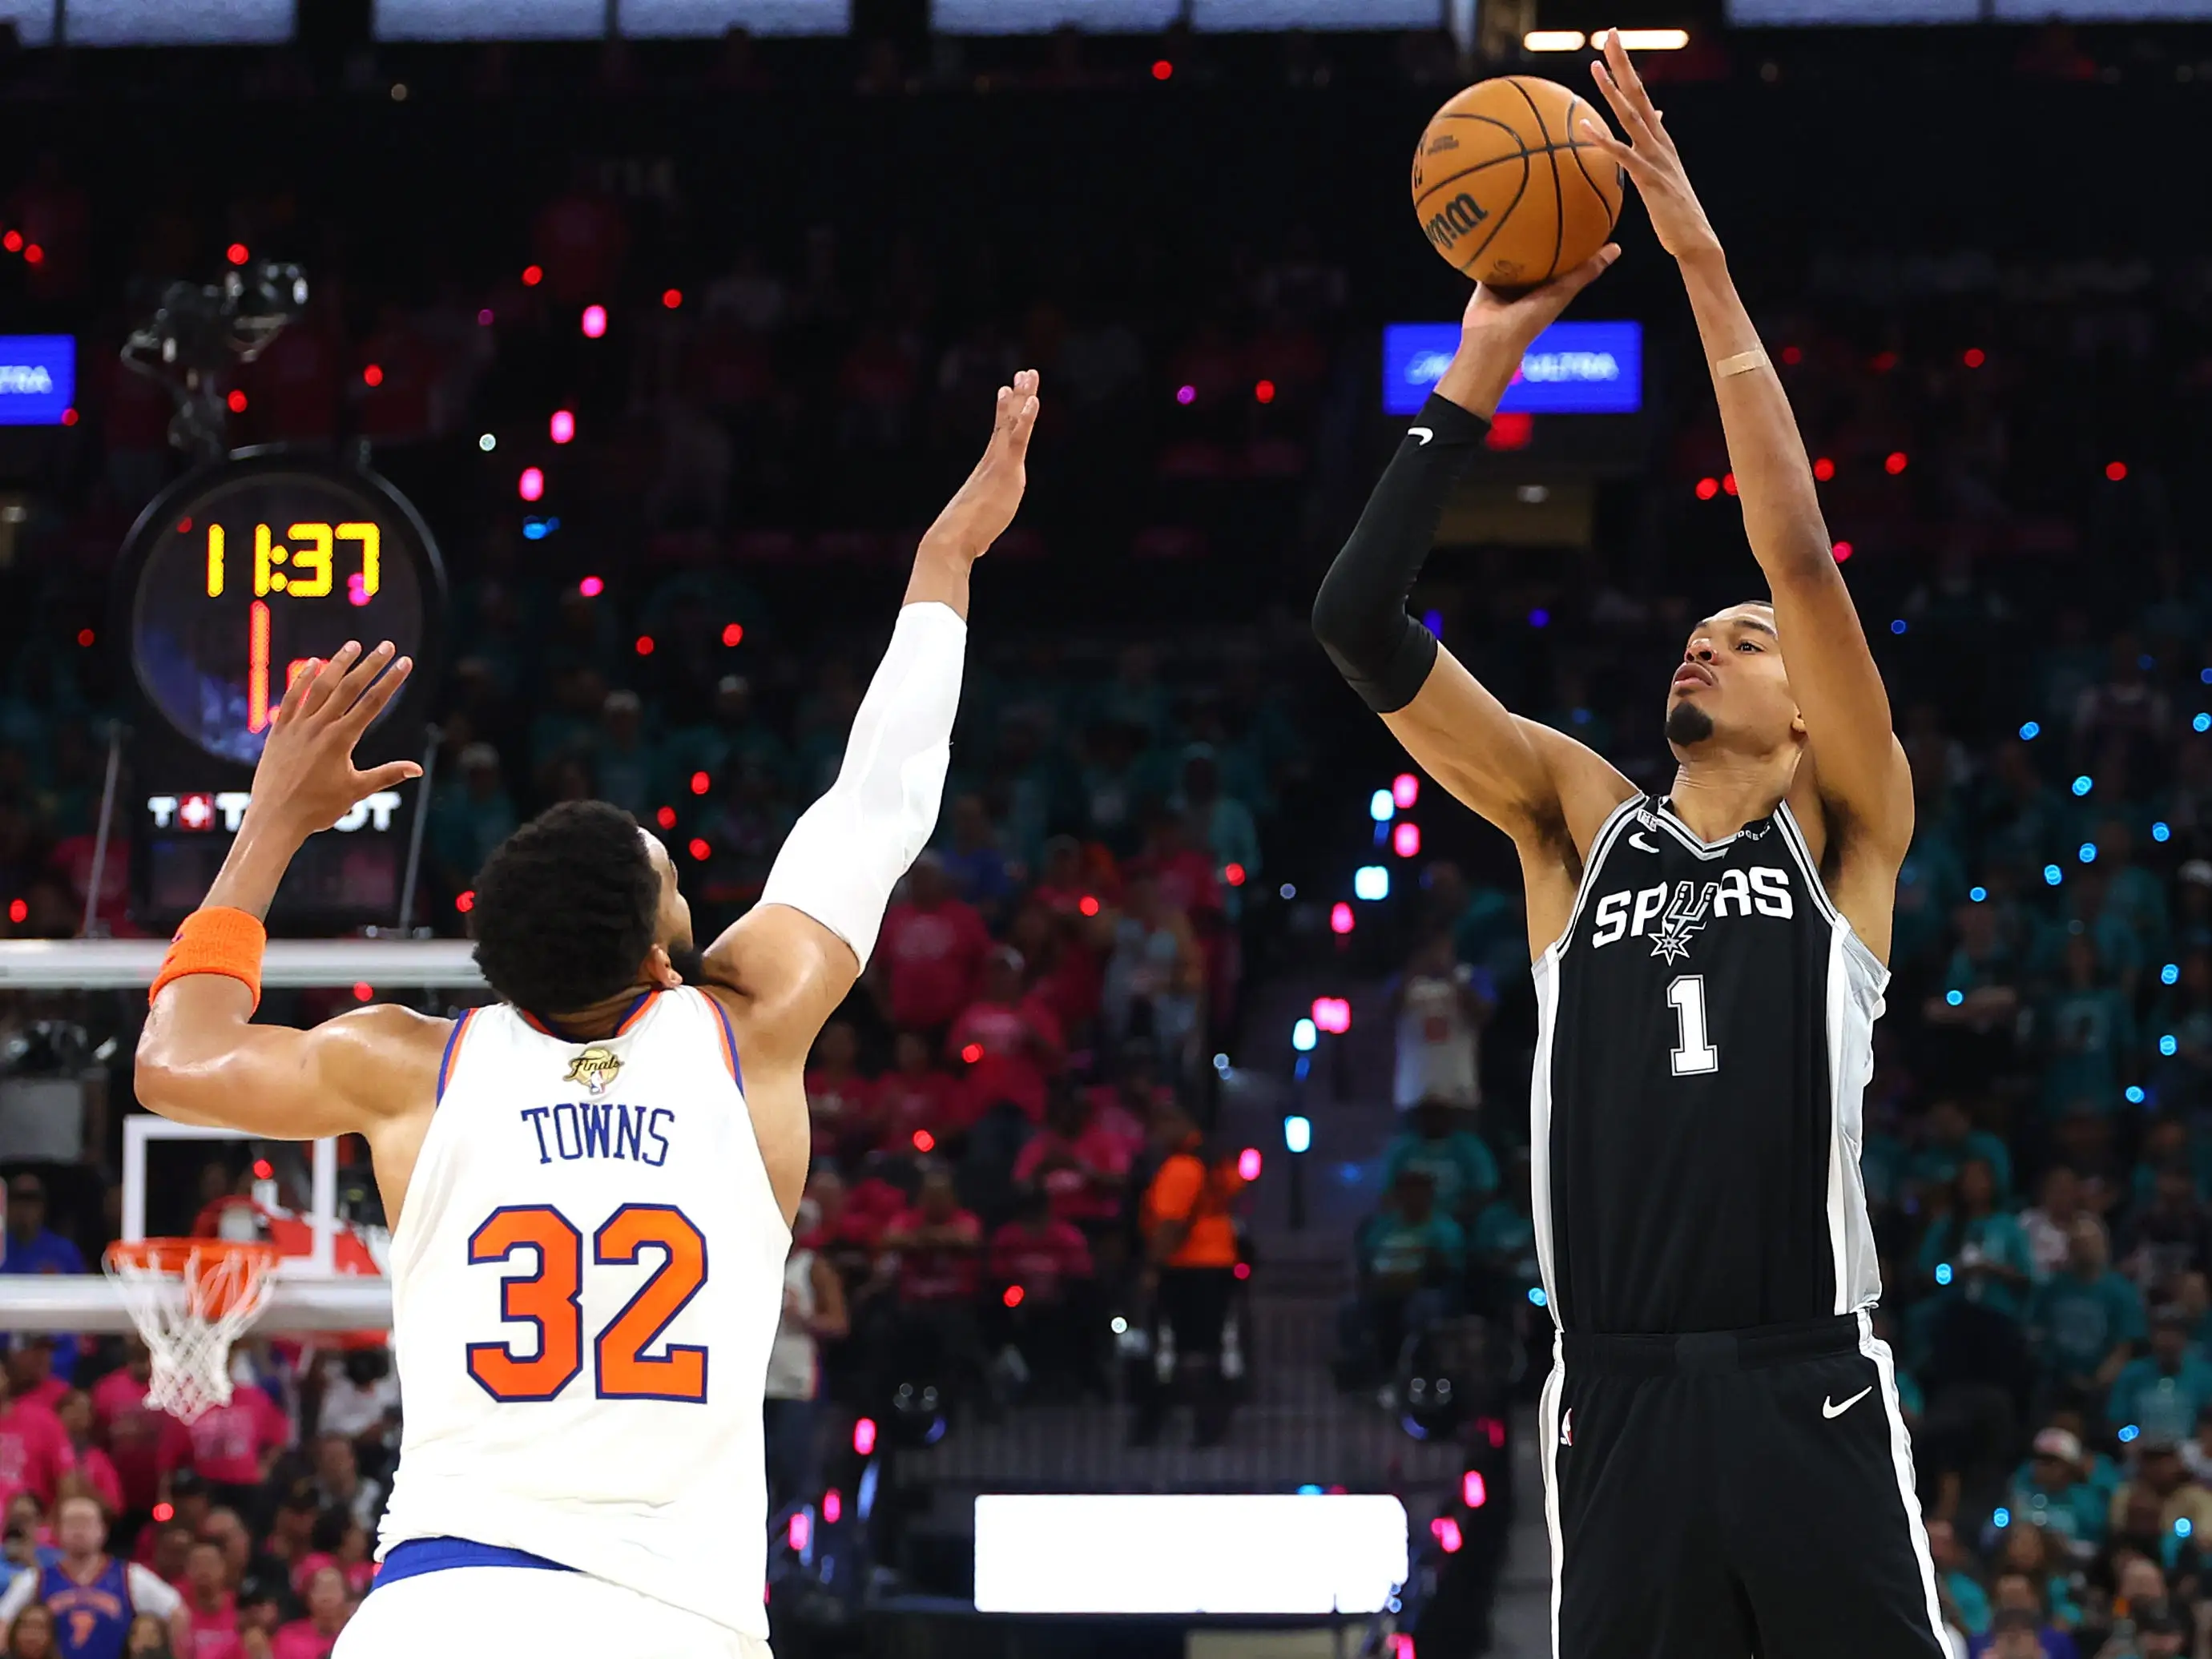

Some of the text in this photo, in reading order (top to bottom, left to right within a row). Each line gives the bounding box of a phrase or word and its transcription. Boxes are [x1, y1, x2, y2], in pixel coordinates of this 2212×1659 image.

[208, 522, 380, 598] 11:37
[1592, 866, 1793, 965] SPURS
[562, 1053, 625, 1081] Finals
[1666, 974, 1719, 1077] 1
[521, 1102, 675, 1167] TOWNS
[465, 1202, 709, 1404] 32
